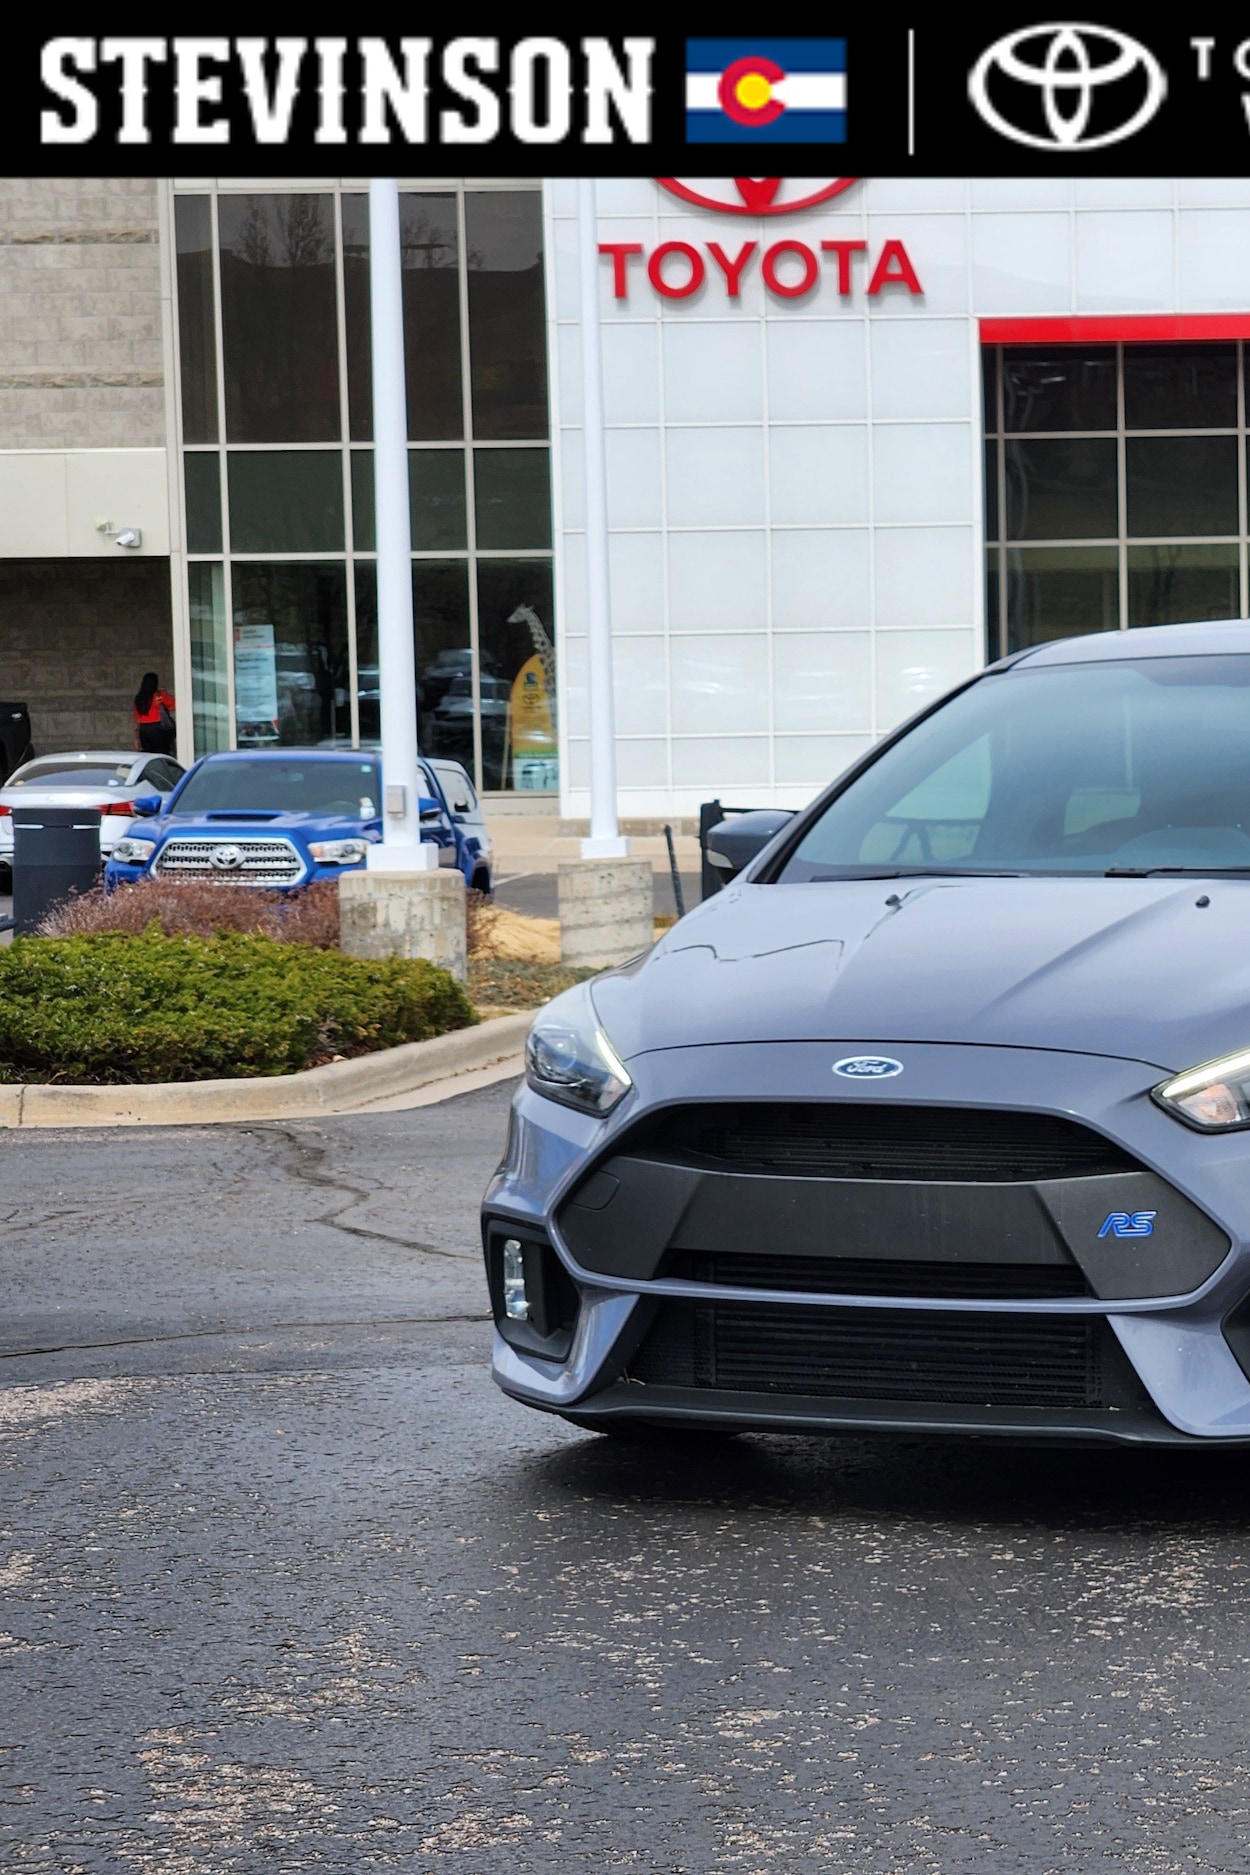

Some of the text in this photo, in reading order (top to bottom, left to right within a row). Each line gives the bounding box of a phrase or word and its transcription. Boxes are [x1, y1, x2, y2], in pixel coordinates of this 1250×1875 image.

[598, 239, 924, 299] TOYOTA
[846, 1060, 888, 1073] Ford
[1097, 1211, 1157, 1238] RS
